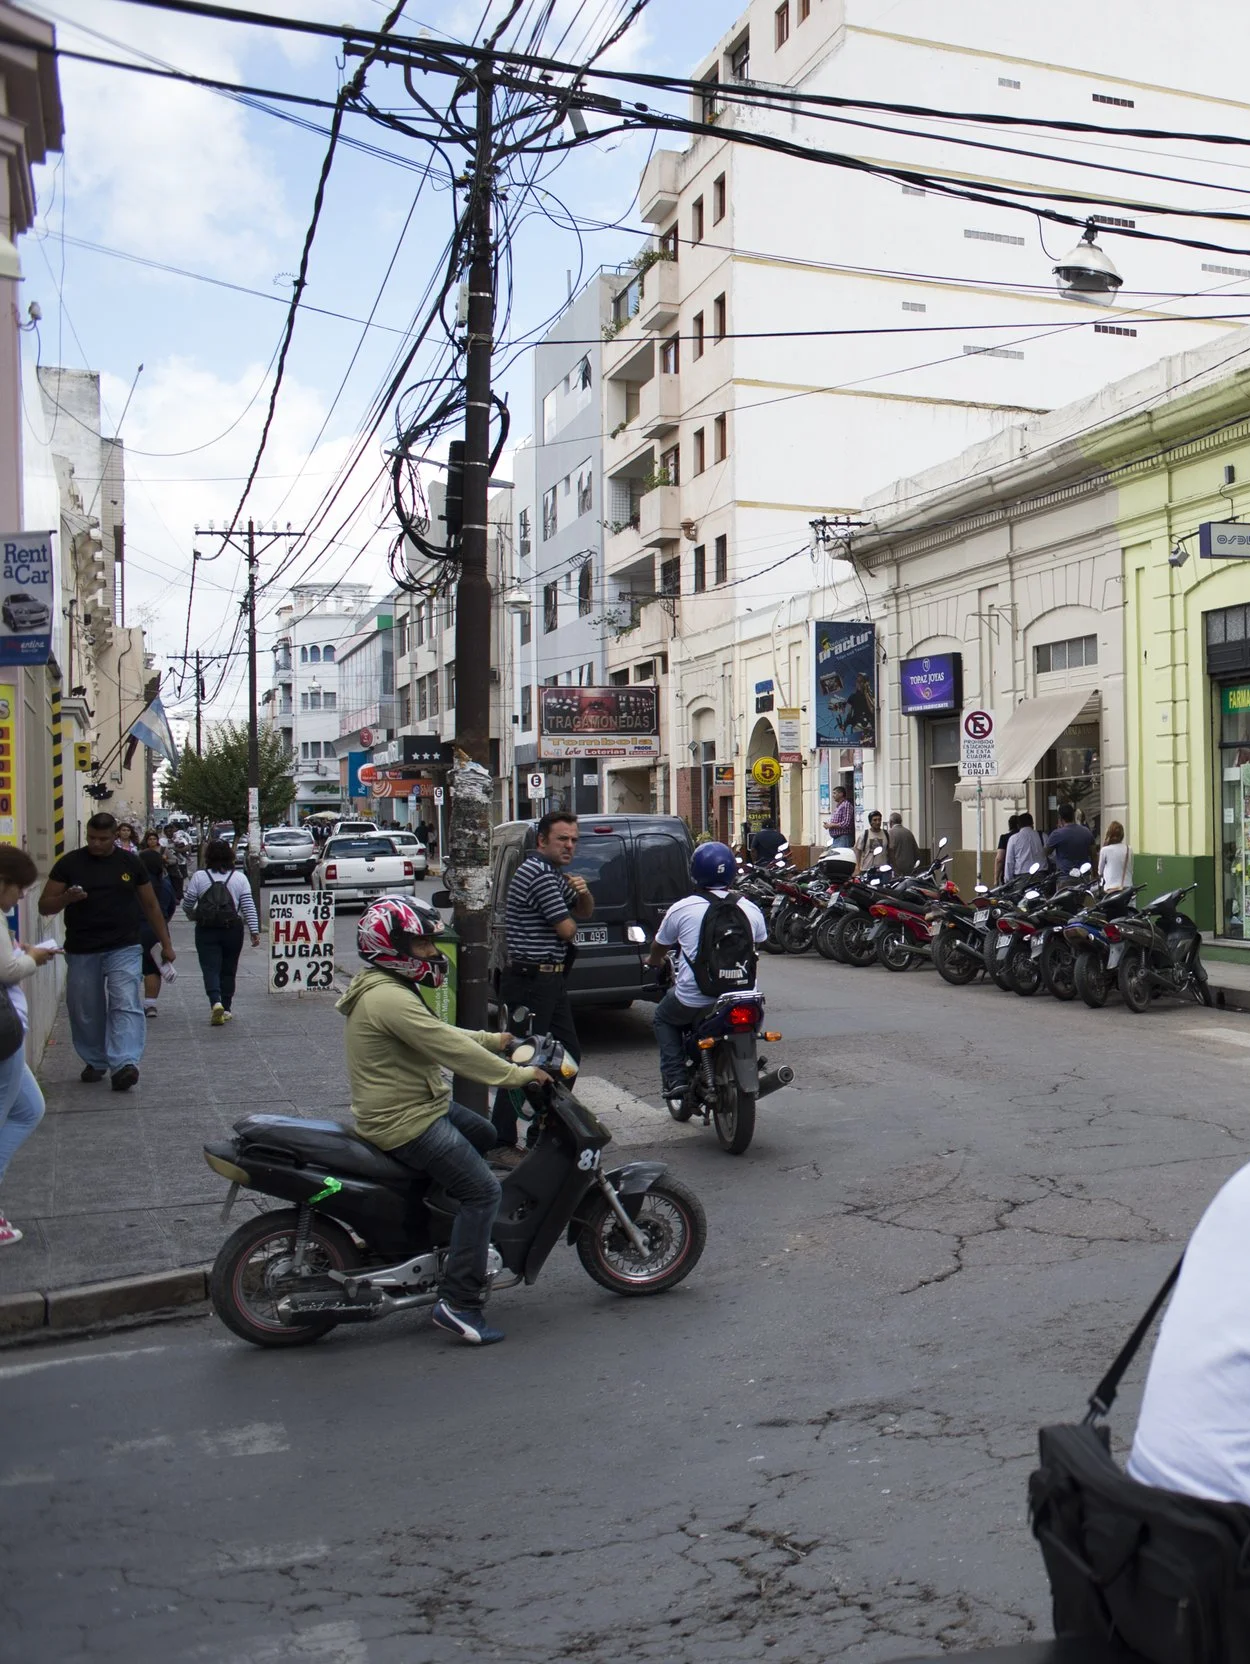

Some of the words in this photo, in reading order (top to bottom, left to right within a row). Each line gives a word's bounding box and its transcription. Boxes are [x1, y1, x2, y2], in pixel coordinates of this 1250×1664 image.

[4, 543, 48, 563] Rent
[3, 565, 13, 579] a
[15, 565, 49, 584] Car
[909, 674, 928, 685] TOPAZ
[928, 672, 945, 685] JOYAS
[547, 715, 650, 729] TRAGAMONEDAS
[972, 717, 984, 734] E
[548, 737, 653, 746] Tombola
[565, 746, 581, 756] Loto
[761, 763, 775, 779] 5
[717, 863, 725, 874] 5
[271, 893, 311, 905] AUTOS
[269, 908, 294, 919] CTAS.
[273, 920, 329, 944] HAY
[590, 931, 606, 941] 493
[272, 943, 334, 959] LUGAR
[274, 961, 289, 988] 8
[293, 969, 302, 982] A
[306, 960, 333, 987] 23
[719, 969, 743, 979] PUMA
[577, 1149, 600, 1170] 81
